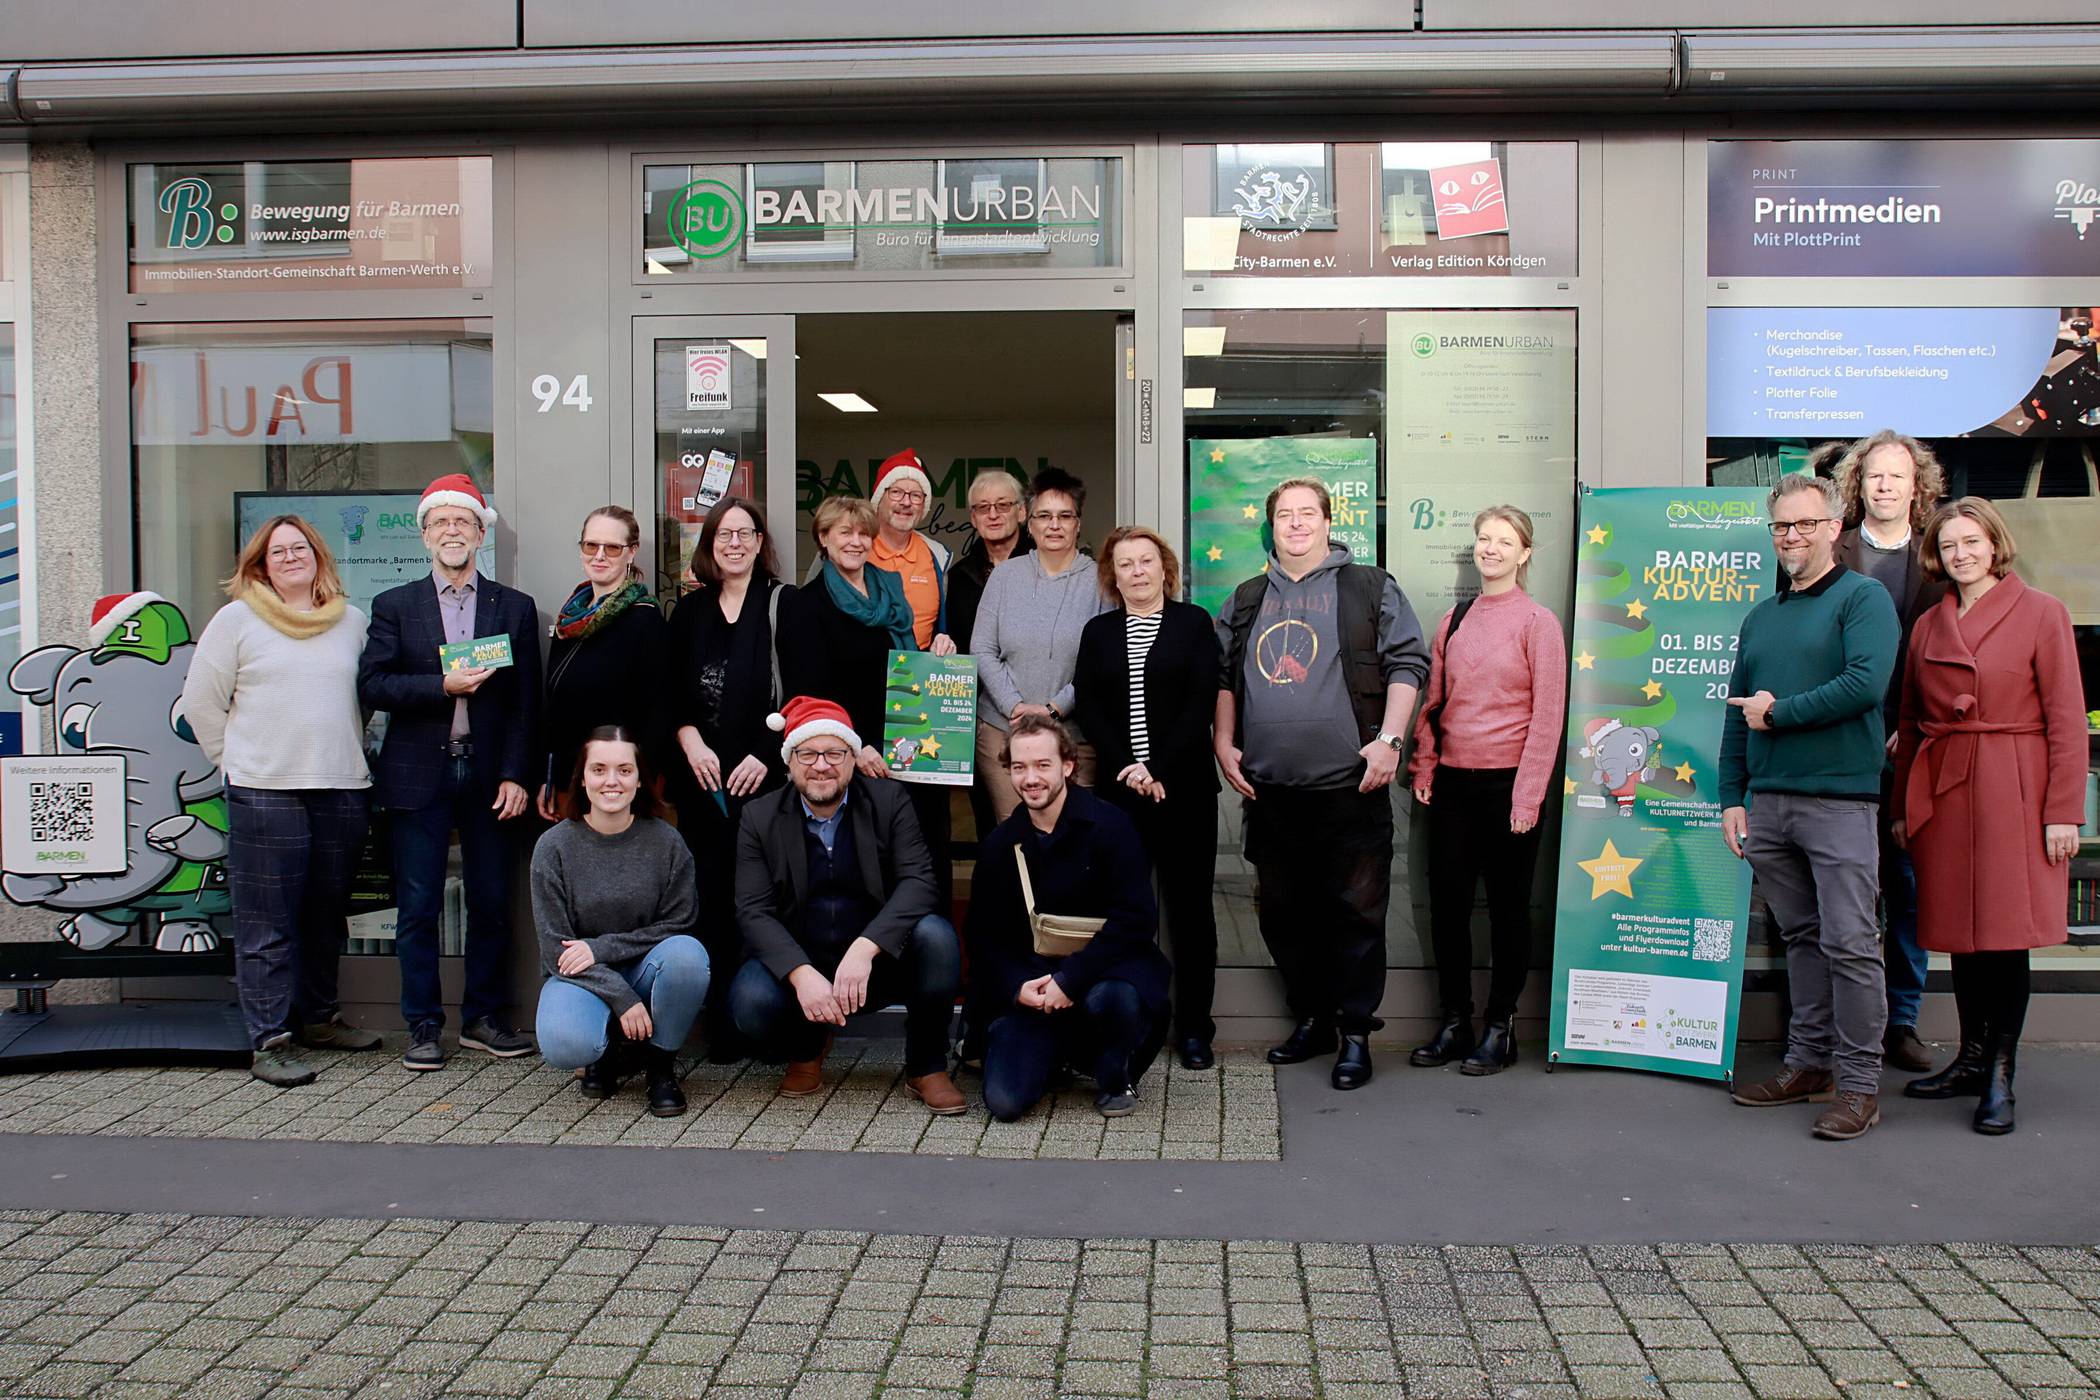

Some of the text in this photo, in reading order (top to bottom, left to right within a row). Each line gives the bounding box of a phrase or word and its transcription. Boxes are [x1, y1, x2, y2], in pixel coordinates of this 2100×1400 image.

[1753, 168, 1798, 180] PRINT
[2056, 179, 2100, 205] Plo
[755, 185, 1100, 224] BARMENURBAN
[1754, 196, 1941, 224] Printmedien
[250, 201, 460, 223] Bewegung für Barmen
[682, 205, 731, 232] BU
[250, 227, 386, 243] www.isgbarmen.de
[1242, 213, 1316, 243] STADTRECHTE SEIT
[876, 231, 909, 247] Büro
[914, 231, 934, 247] für
[1753, 231, 1861, 247] Mit PlottPrint
[1233, 255, 1337, 270] City-Barmen e.V.
[1391, 254, 1546, 269] Verlag Edition Köndgen
[144, 263, 475, 280] Immobilien-Standort-Gemeinschaft Barmen-Werth e.V.
[1440, 336, 1554, 348] BARMENURBAN
[1766, 329, 1843, 341] Merchandise
[1766, 344, 1996, 358] (Kugelschreiber, Tassen, Flaschen etc.)
[1766, 365, 1949, 379] Textildruck & Berufsbekleidung
[532, 374, 593, 412] 94
[690, 392, 728, 403] Freifunk
[1766, 386, 1838, 399] Plotter Folie
[1766, 408, 1864, 422] Transferpressen
[681, 426, 725, 437] Mit einer App
[1324, 481, 1368, 497] MER
[1668, 500, 1756, 517] BARMEN
[1330, 510, 1369, 526] ENT
[1351, 531, 1369, 543] 24.
[335, 556, 388, 565] tandortmarke
[1655, 550, 1761, 570] BARMER
[1643, 566, 1749, 587] KULTUR-
[1653, 583, 1760, 602] ADVENT
[1660, 634, 1687, 651] 01.
[1694, 635, 1723, 651] BIS
[1651, 658, 1732, 675] DEZEMB
[924, 680, 968, 690] KULTUR-
[929, 673, 975, 685] BARMER
[928, 688, 973, 699] ADVENT
[1705, 682, 1729, 699] 20
[940, 706, 973, 714] DEZEMBER
[953, 699, 963, 707] BIS
[10, 766, 117, 775] Weitere Informationen
[1645, 799, 1721, 810] Eine Gemeinschaftsakt
[1649, 808, 1715, 819] KULTURNETZWERK
[36, 851, 86, 861] BARMEN
[1594, 864, 1625, 873] EINTRITT
[1611, 912, 1690, 926] #barmerkulturadvent
[1617, 923, 1690, 937] Alle Programminfos
[1619, 934, 1689, 947] und Flyerdownload
[1600, 943, 1688, 957] unter kultur-barmen.de
[1677, 1017, 1718, 1031] KULTUR
[1675, 1036, 1717, 1050] BARMEN
